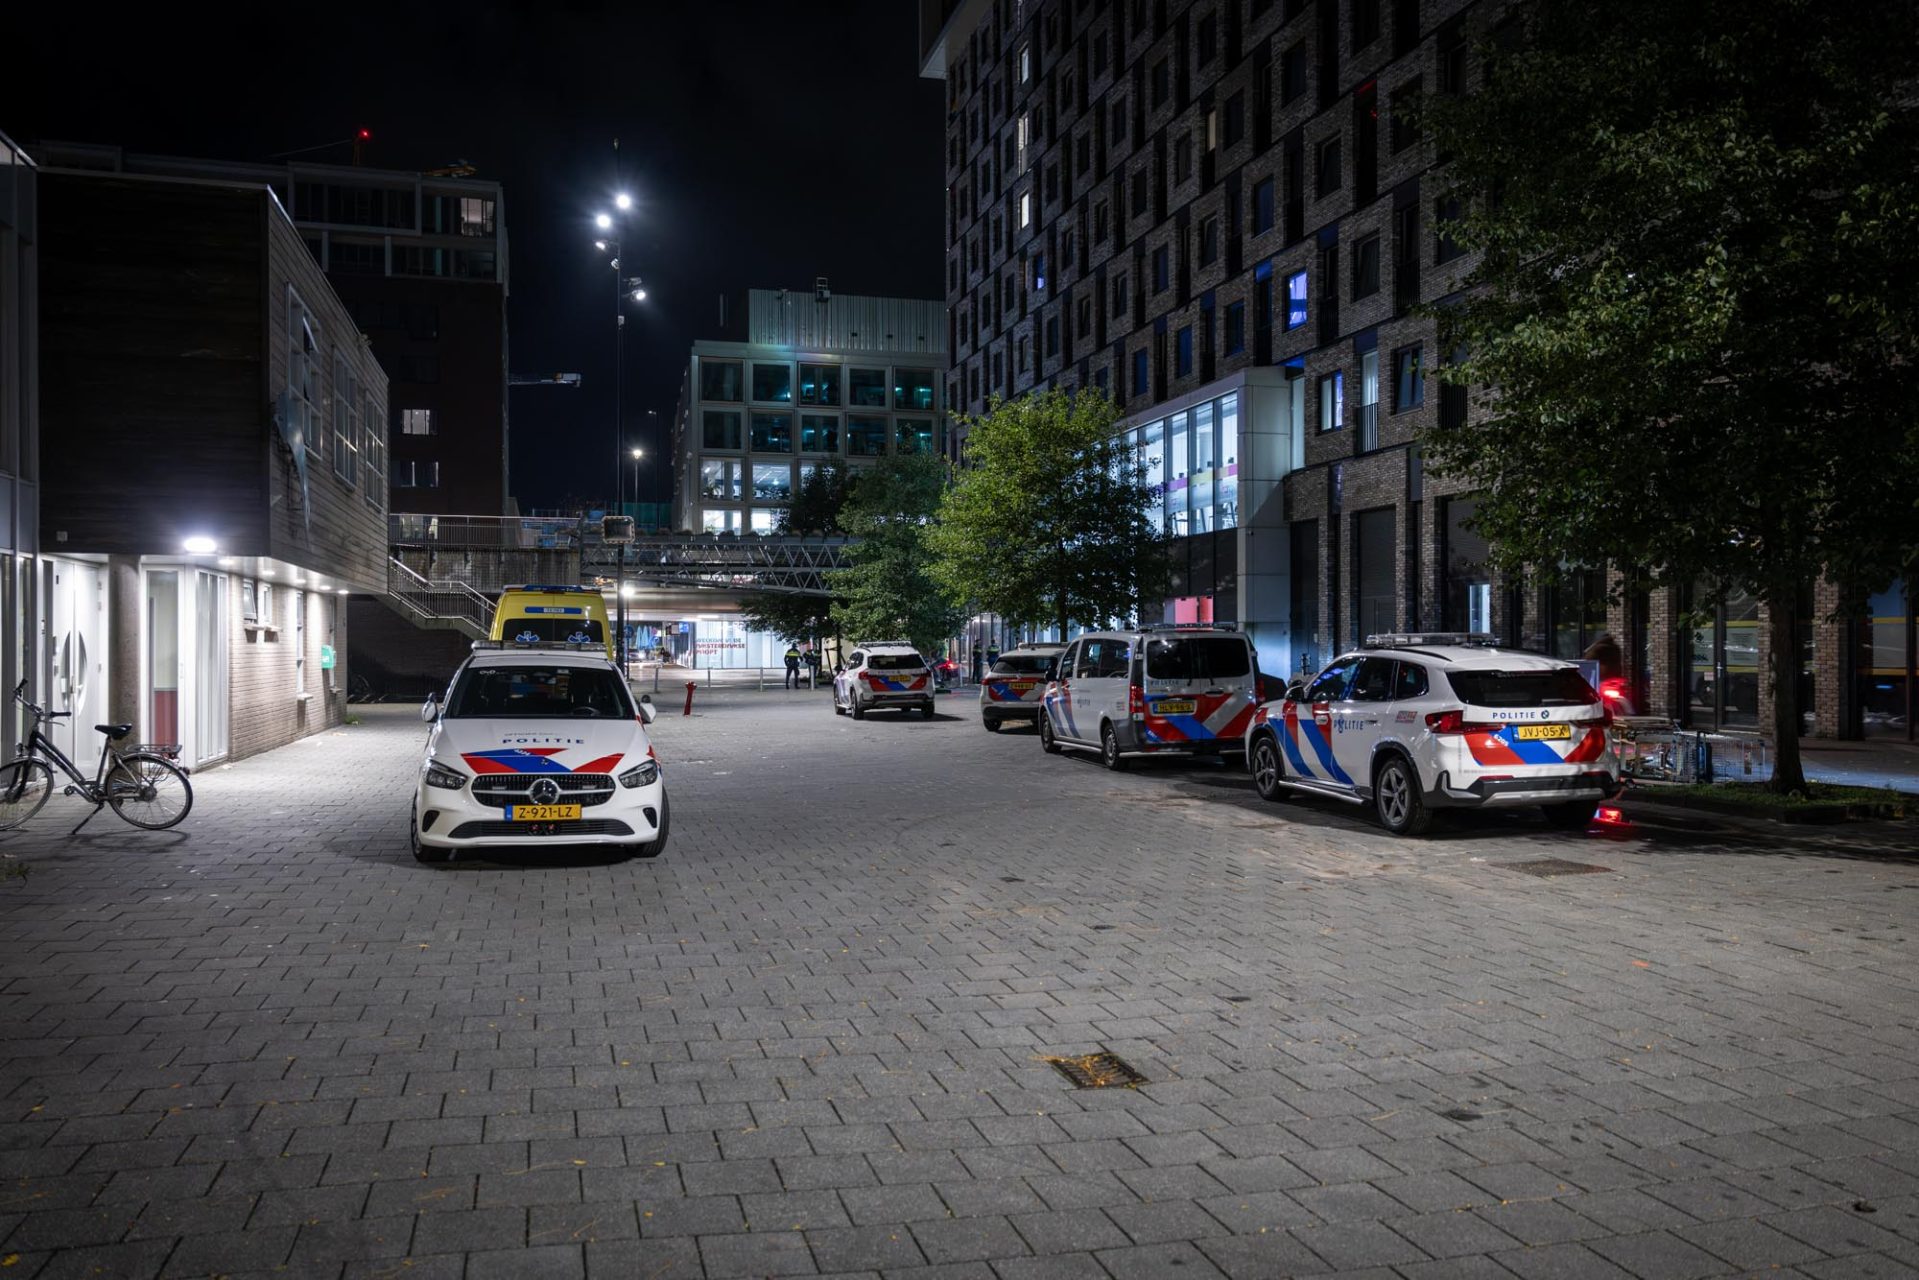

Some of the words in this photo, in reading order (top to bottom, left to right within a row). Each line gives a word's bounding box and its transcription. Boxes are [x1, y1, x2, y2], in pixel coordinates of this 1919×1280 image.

[1492, 711, 1536, 719] POLITIE
[1522, 727, 1566, 738] JVJ-05-X
[518, 806, 572, 818] Z-921-LZ
